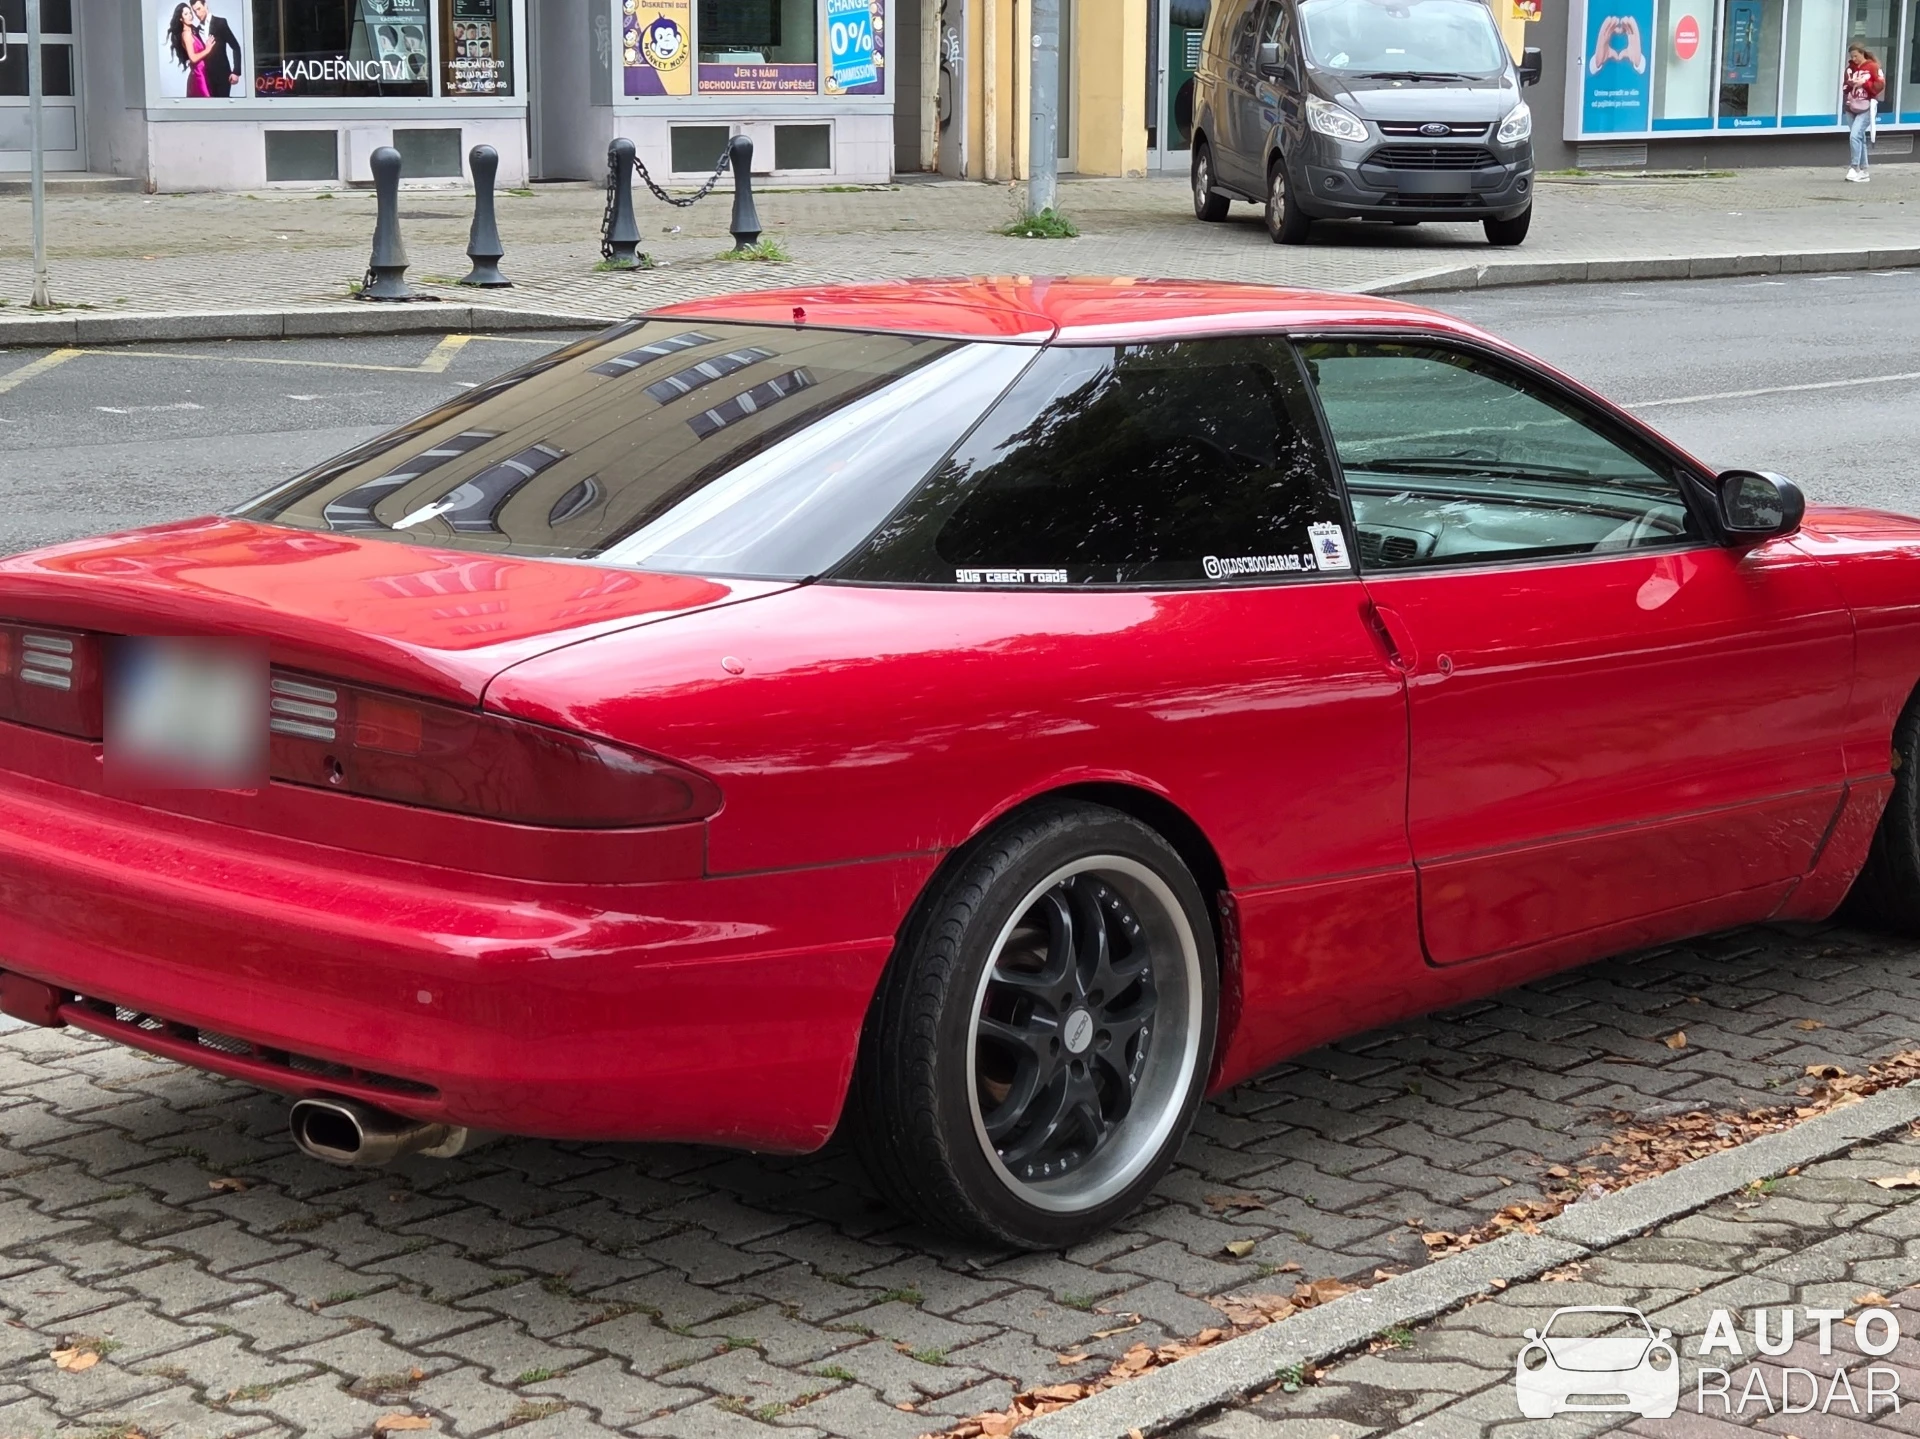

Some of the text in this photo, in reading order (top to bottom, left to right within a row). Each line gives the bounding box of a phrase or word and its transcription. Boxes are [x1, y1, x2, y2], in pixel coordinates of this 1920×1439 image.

[831, 20, 872, 56] 0%
[644, 42, 688, 69] MONKEY MONEY
[282, 55, 407, 81] KADEŘNICTVÍ
[752, 69, 757, 77] S
[759, 67, 779, 77] NÁMI
[255, 76, 294, 90] OPEN
[699, 80, 755, 90] OBCHODUJETE
[756, 79, 776, 89] VŽDY
[956, 569, 981, 583] 90s
[1030, 569, 1068, 583] roads
